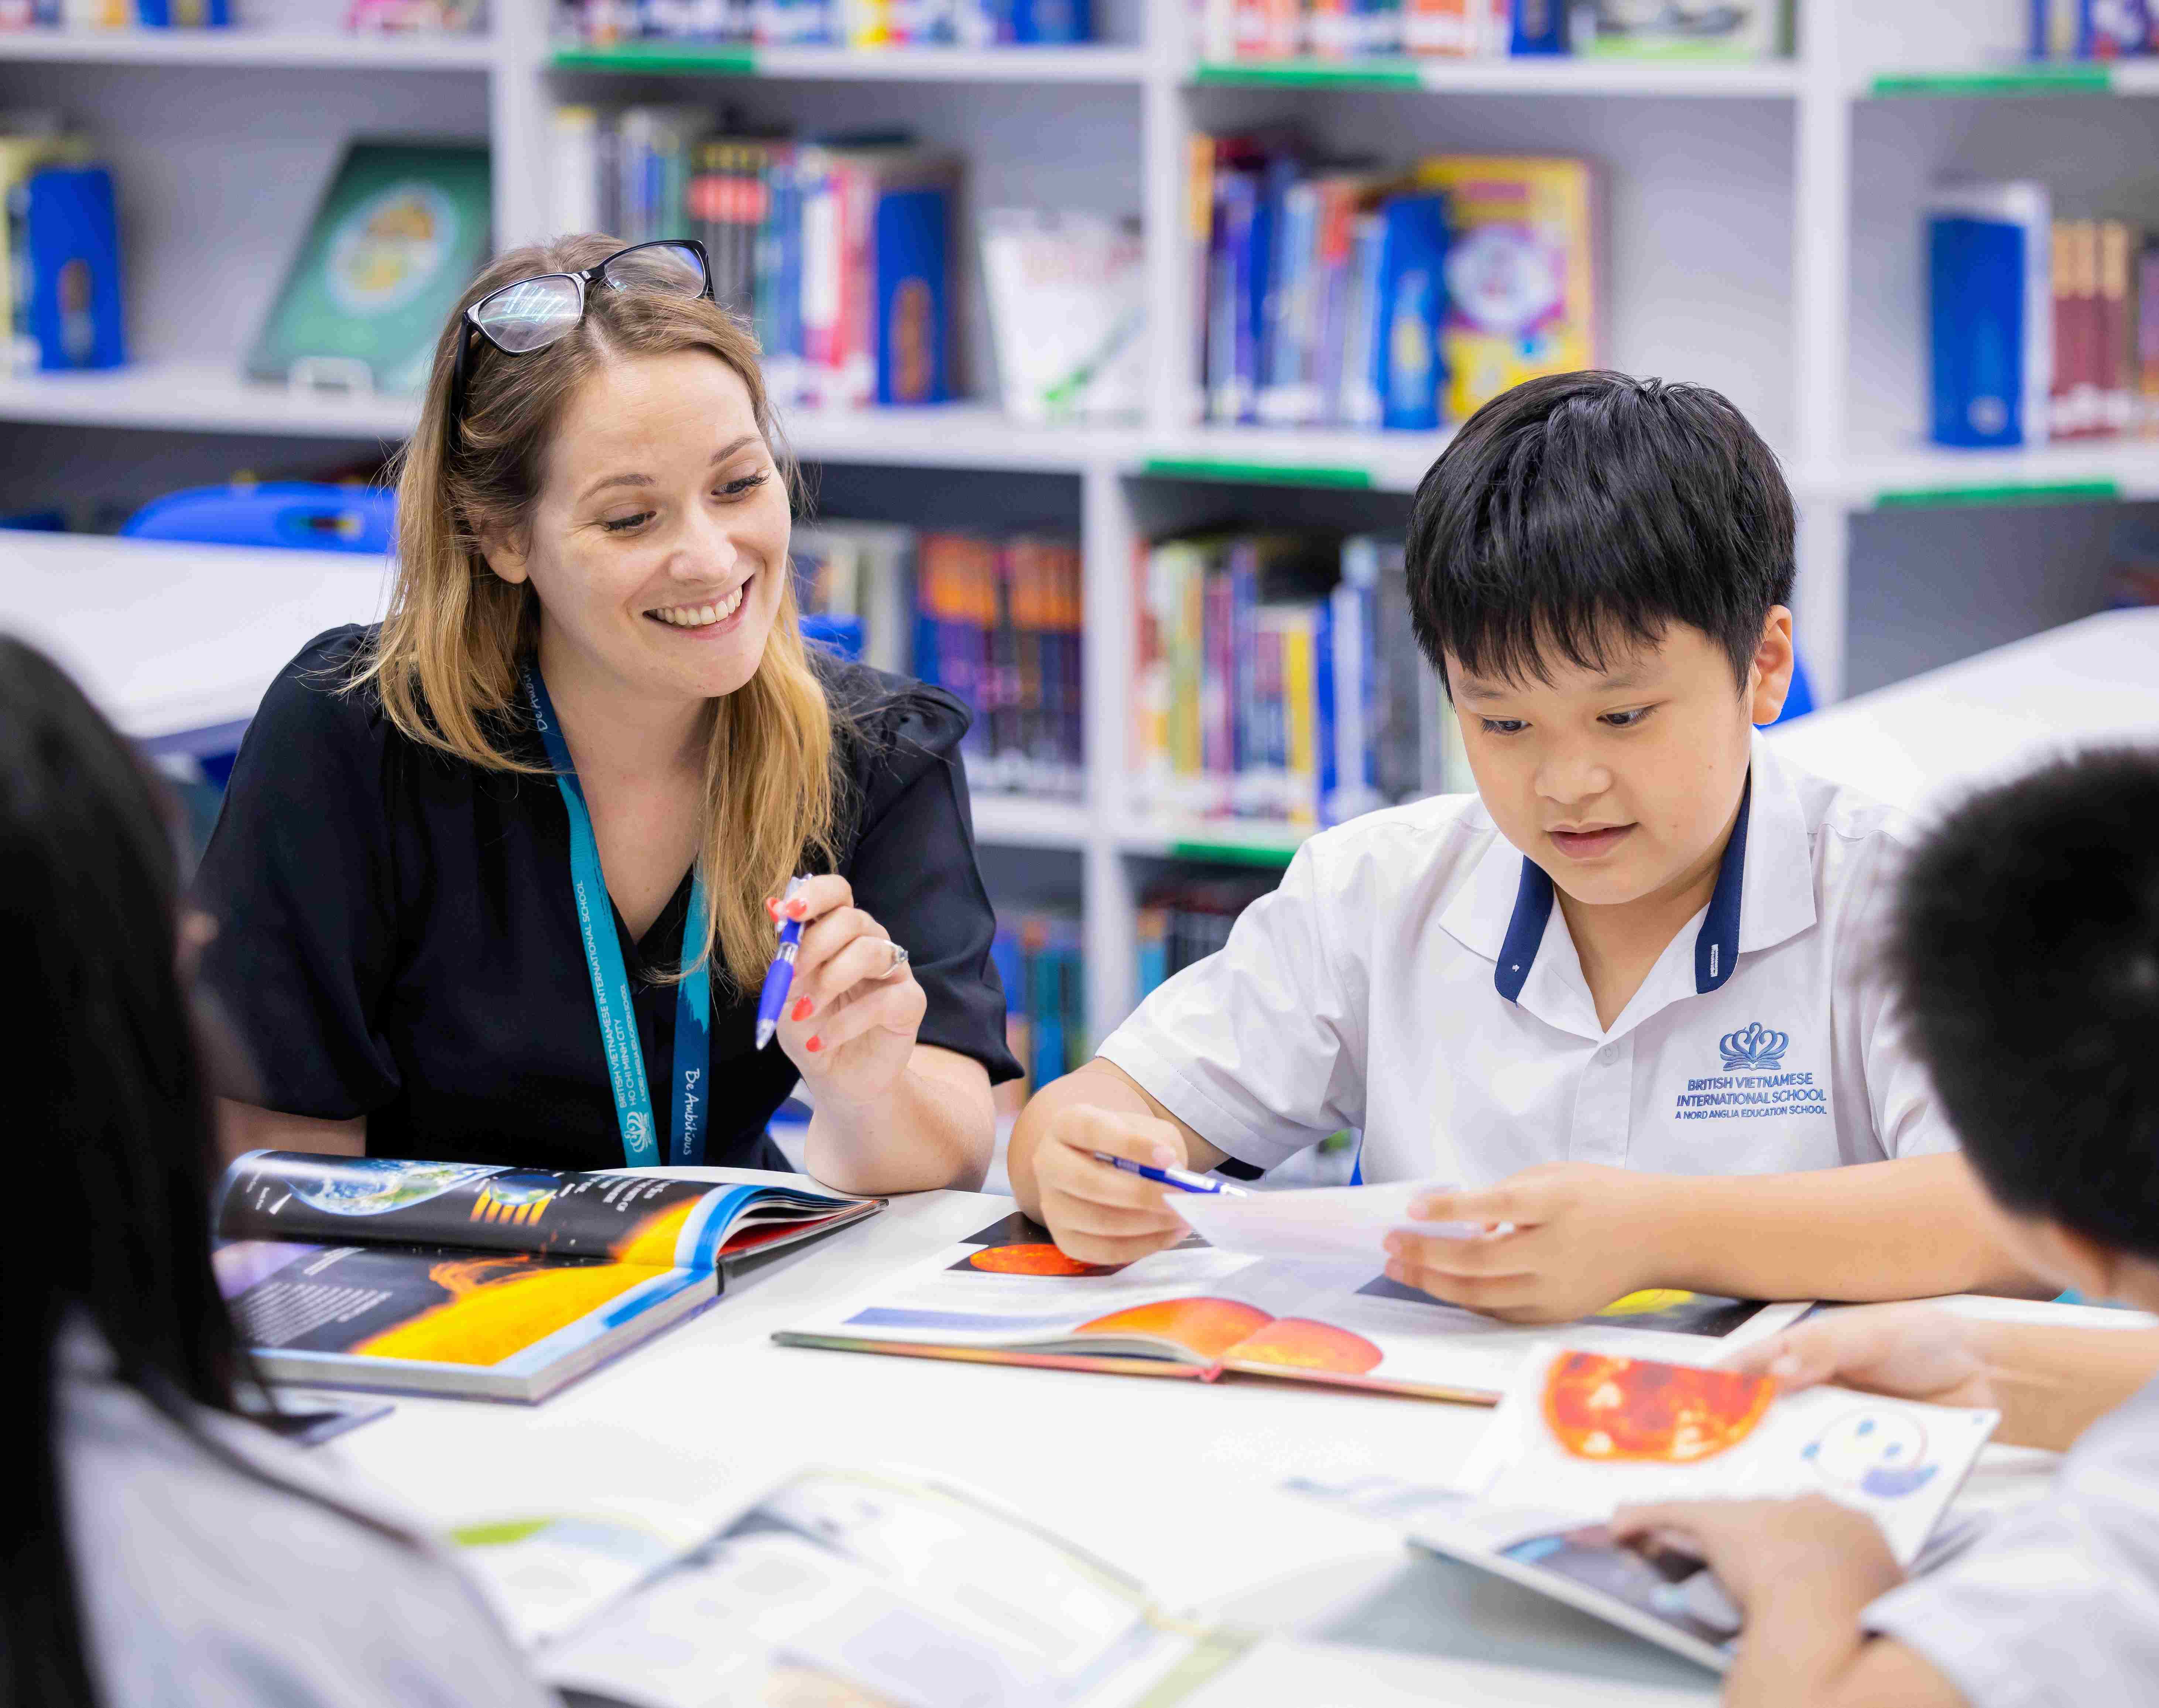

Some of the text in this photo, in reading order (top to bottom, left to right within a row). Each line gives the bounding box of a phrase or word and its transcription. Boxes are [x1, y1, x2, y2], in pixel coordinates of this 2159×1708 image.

[577, 880, 627, 1108] BRITISH VIETNAMESE INTERNATIONAL SCHOOL
[614, 1019, 637, 1106] HO CHI MINH CITY
[1688, 1072, 1813, 1091] BRITISH VIETNAMESE
[683, 1068, 700, 1155] Be Ambitious
[1675, 1105, 1827, 1119] A NORD ANGLIA EDUCATION SCHOOL
[1677, 1088, 1827, 1107] INTERNATIONAL SCHOOL
